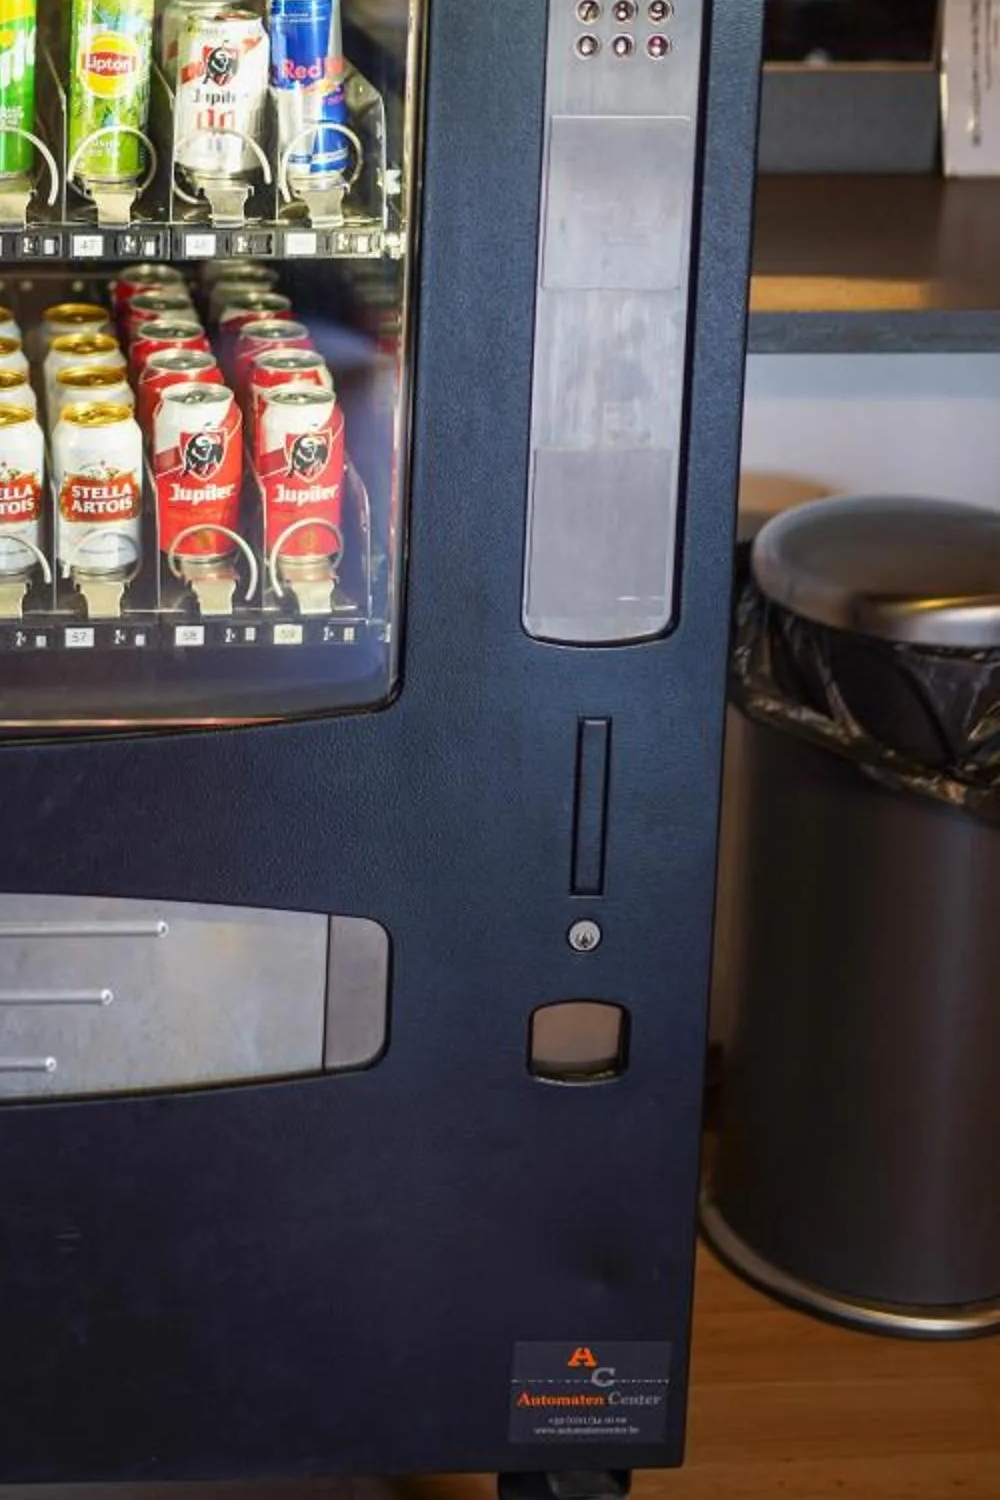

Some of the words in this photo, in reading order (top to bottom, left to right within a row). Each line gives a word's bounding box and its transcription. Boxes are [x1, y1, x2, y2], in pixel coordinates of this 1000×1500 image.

[86, 54, 132, 73] Lipton
[284, 57, 321, 80] Red
[71, 484, 132, 501] STELLA
[168, 483, 236, 507] Jupiler
[273, 483, 339, 507] Jupiler
[71, 498, 133, 514] ARTOIS
[567, 1347, 598, 1369] A
[591, 1367, 616, 1388] C
[517, 1391, 606, 1407] Automaten
[607, 1390, 662, 1406] Center
